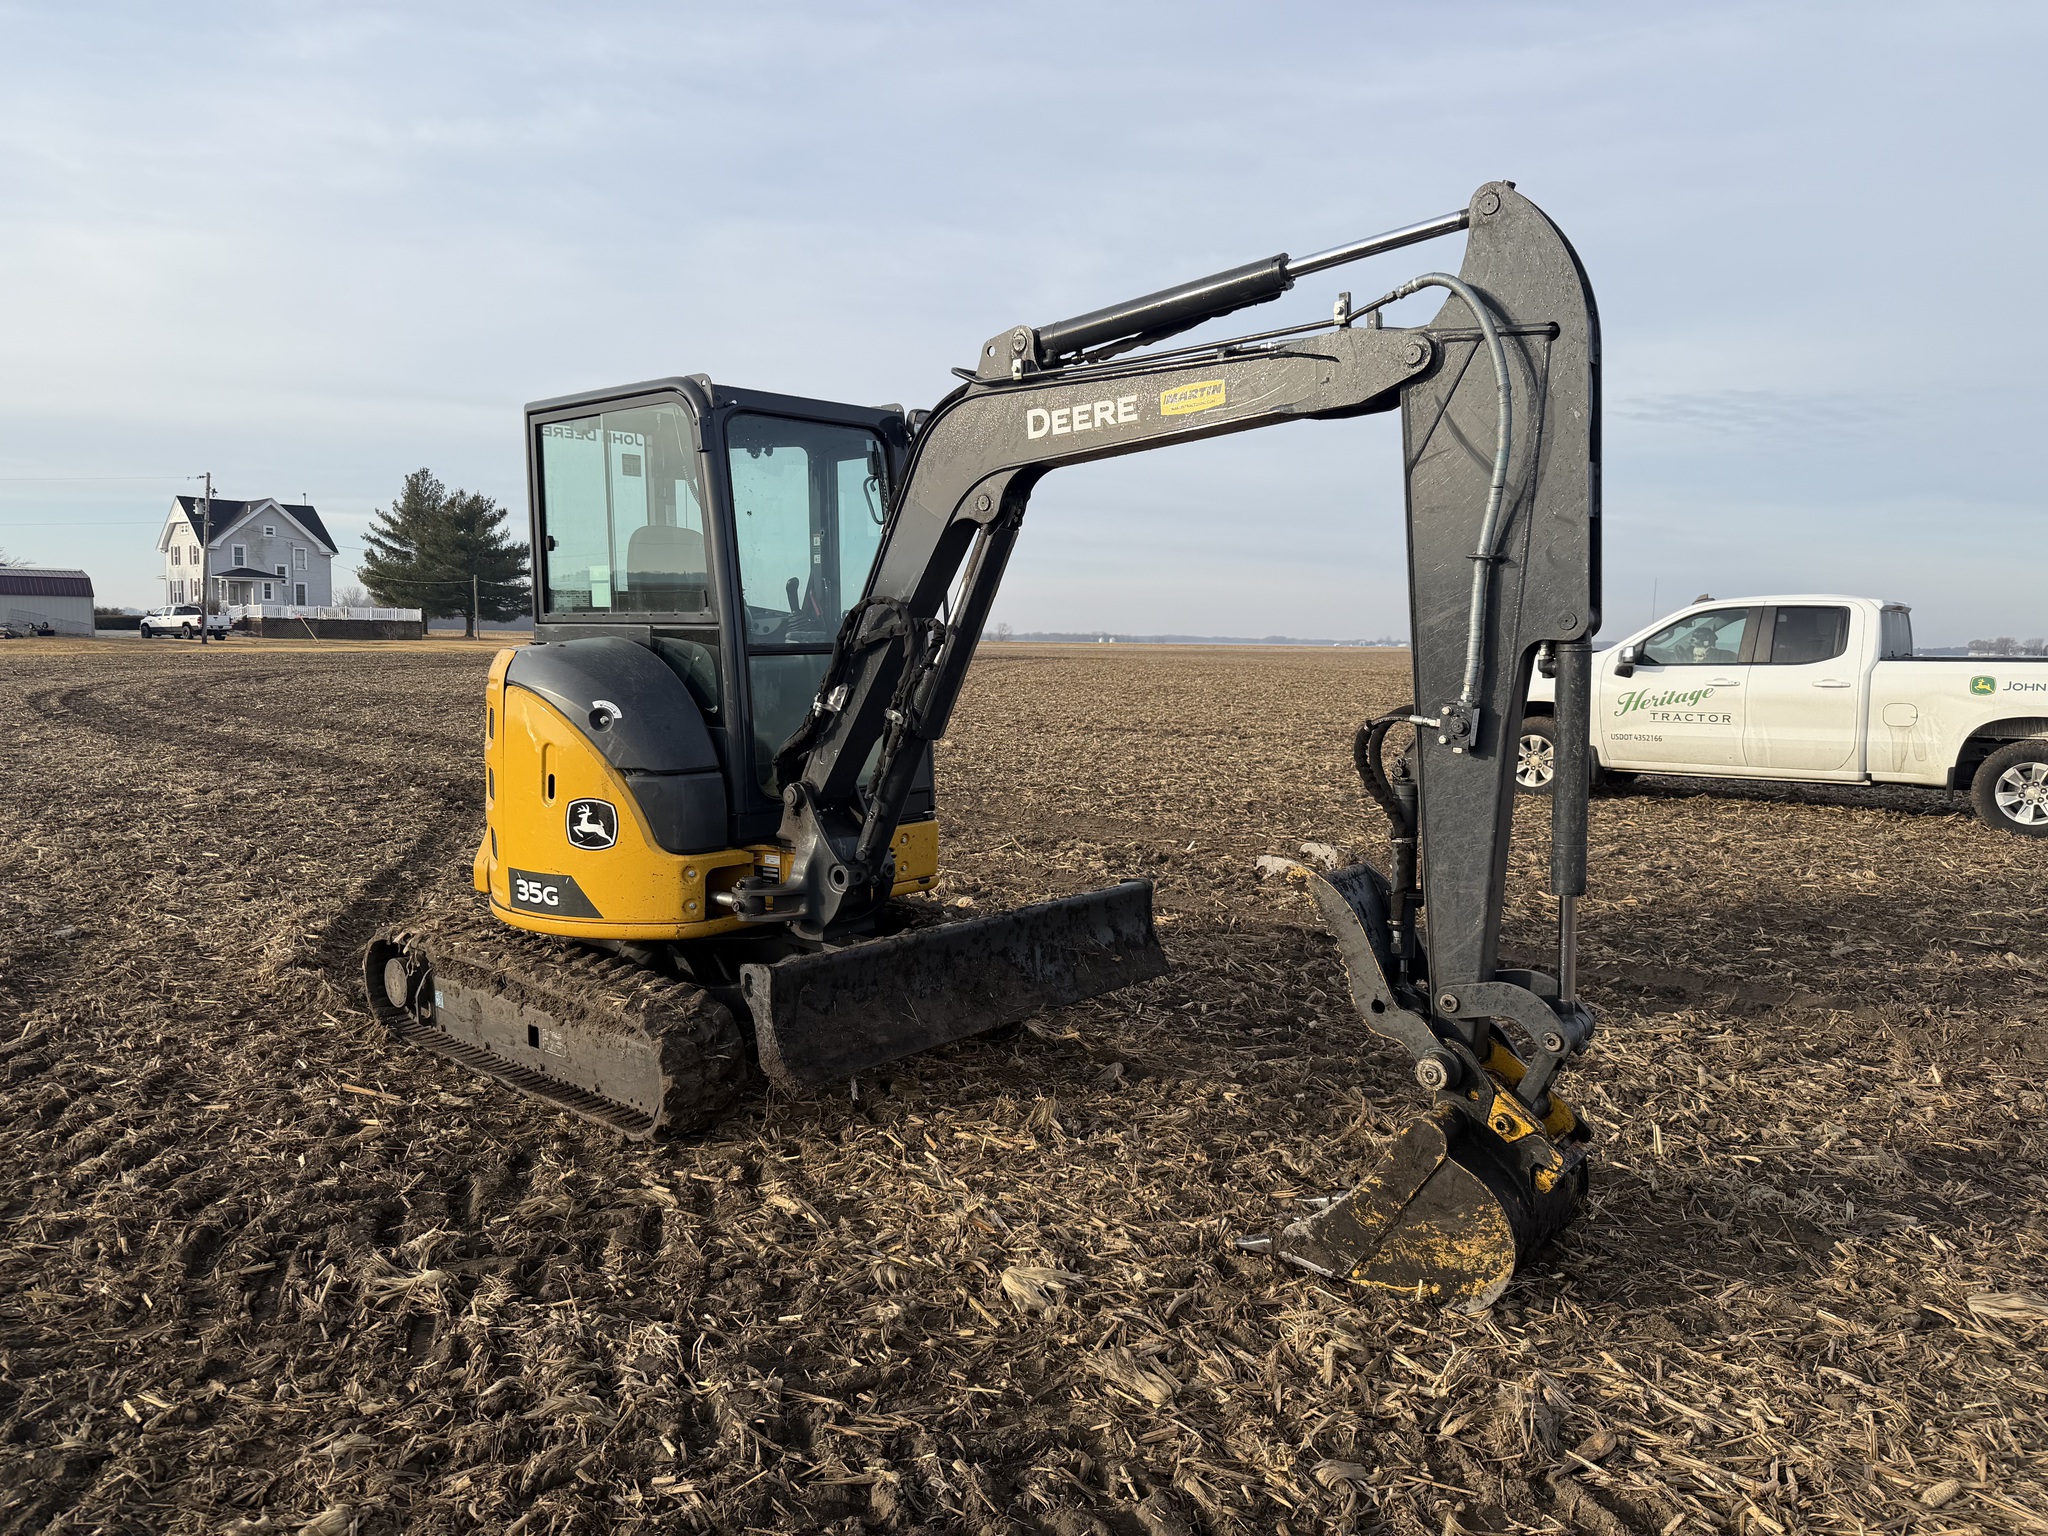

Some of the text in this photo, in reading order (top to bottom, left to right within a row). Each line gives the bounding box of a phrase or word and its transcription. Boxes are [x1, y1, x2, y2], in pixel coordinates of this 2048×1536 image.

[1163, 383, 1222, 406] MARTIN
[1026, 395, 1138, 440] DEERE
[2002, 681, 2047, 692] JOHN
[1613, 687, 1716, 717] Heritage
[1650, 712, 1732, 723] TRACTOR
[1610, 733, 1663, 742] USDOT 4352166
[516, 879, 559, 906] 35G
